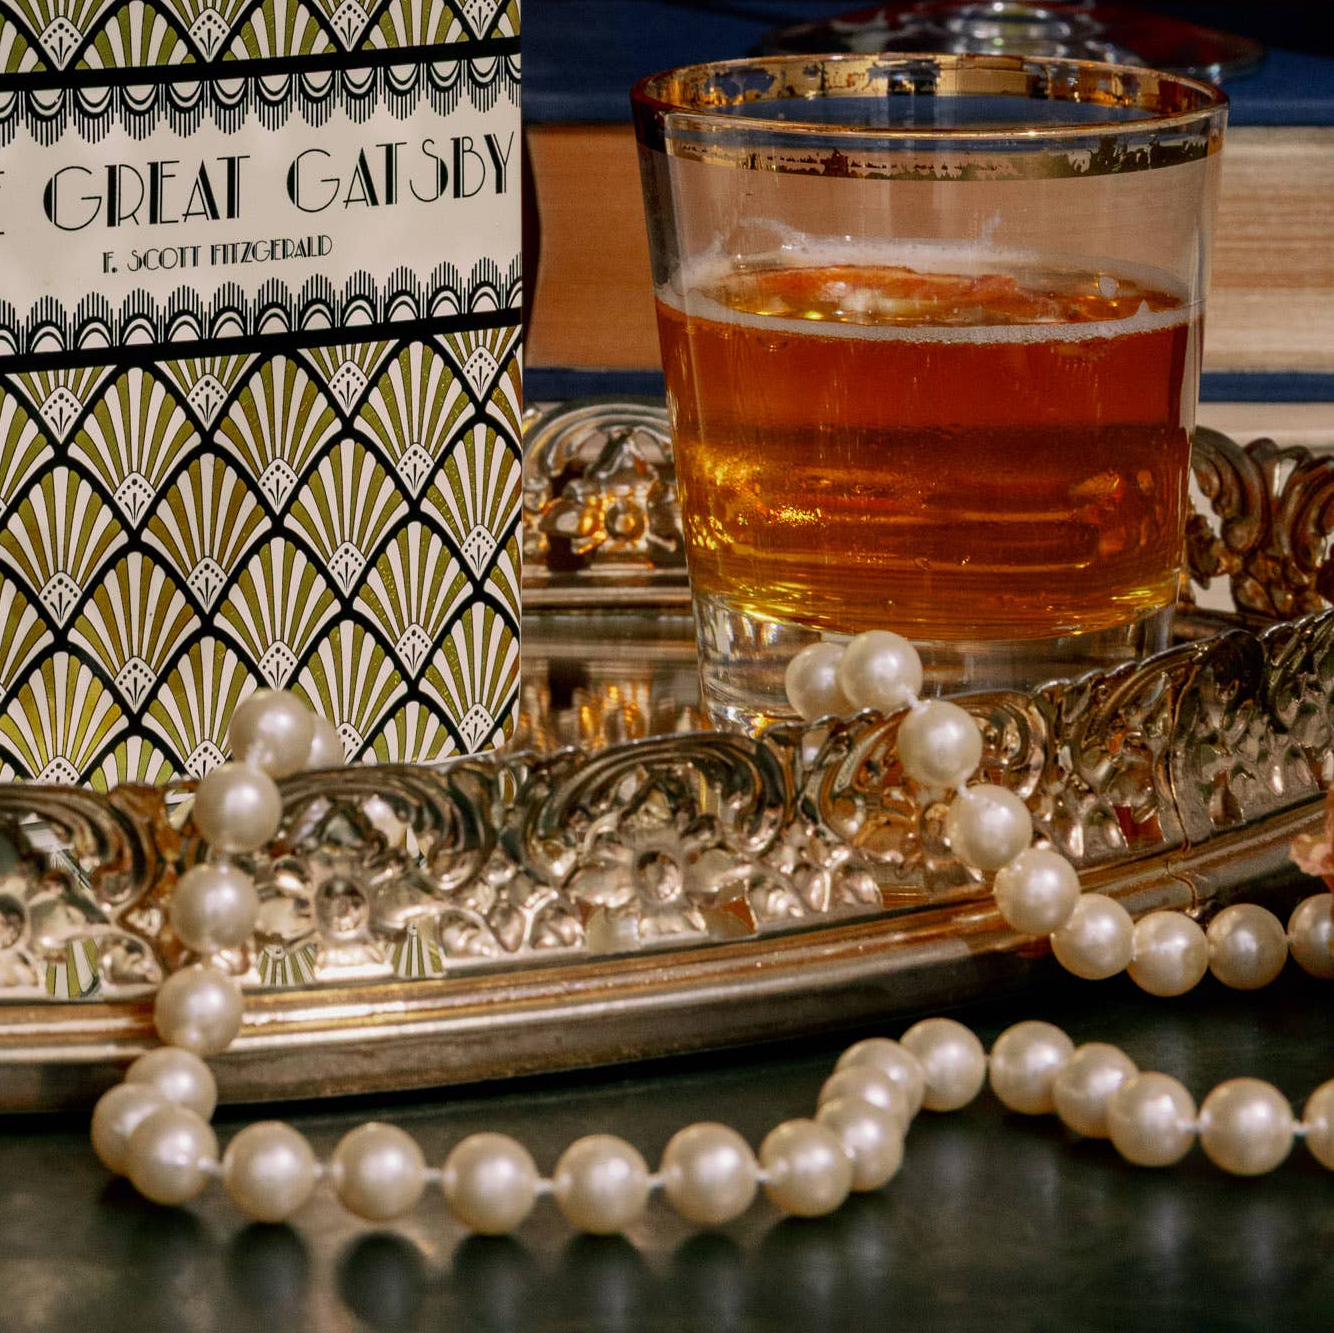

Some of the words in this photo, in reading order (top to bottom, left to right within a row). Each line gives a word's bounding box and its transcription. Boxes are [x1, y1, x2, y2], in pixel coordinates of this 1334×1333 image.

[42, 155, 251, 231] GREAT
[286, 131, 515, 214] GATSBY
[102, 250, 118, 274] F.
[126, 245, 202, 272] SCOTT
[210, 234, 333, 266] FITZGERALD
